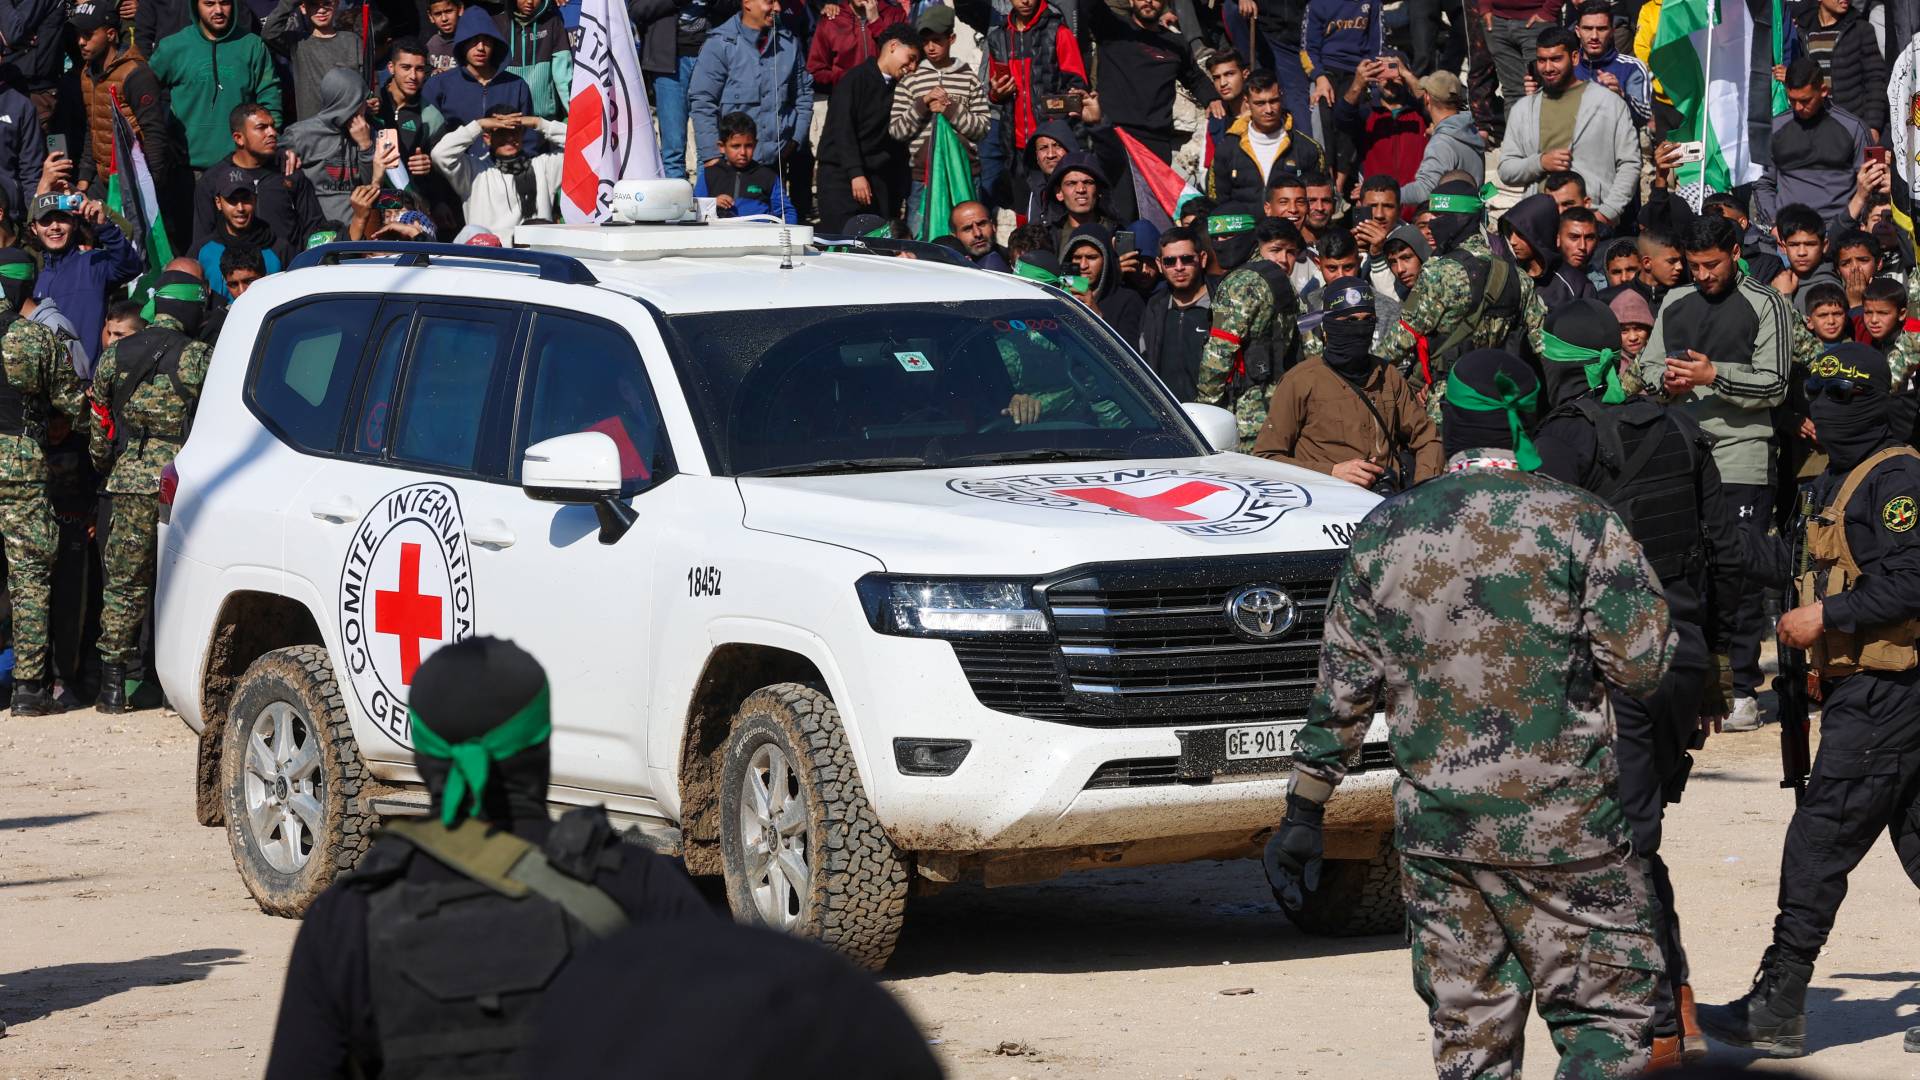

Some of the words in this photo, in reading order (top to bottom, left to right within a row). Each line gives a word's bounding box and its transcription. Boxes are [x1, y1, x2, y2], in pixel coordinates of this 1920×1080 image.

[1839, 362, 1870, 379] سرايا
[344, 522, 378, 675] COMITE
[388, 488, 470, 643] INTERNATION
[688, 566, 722, 597] 18452
